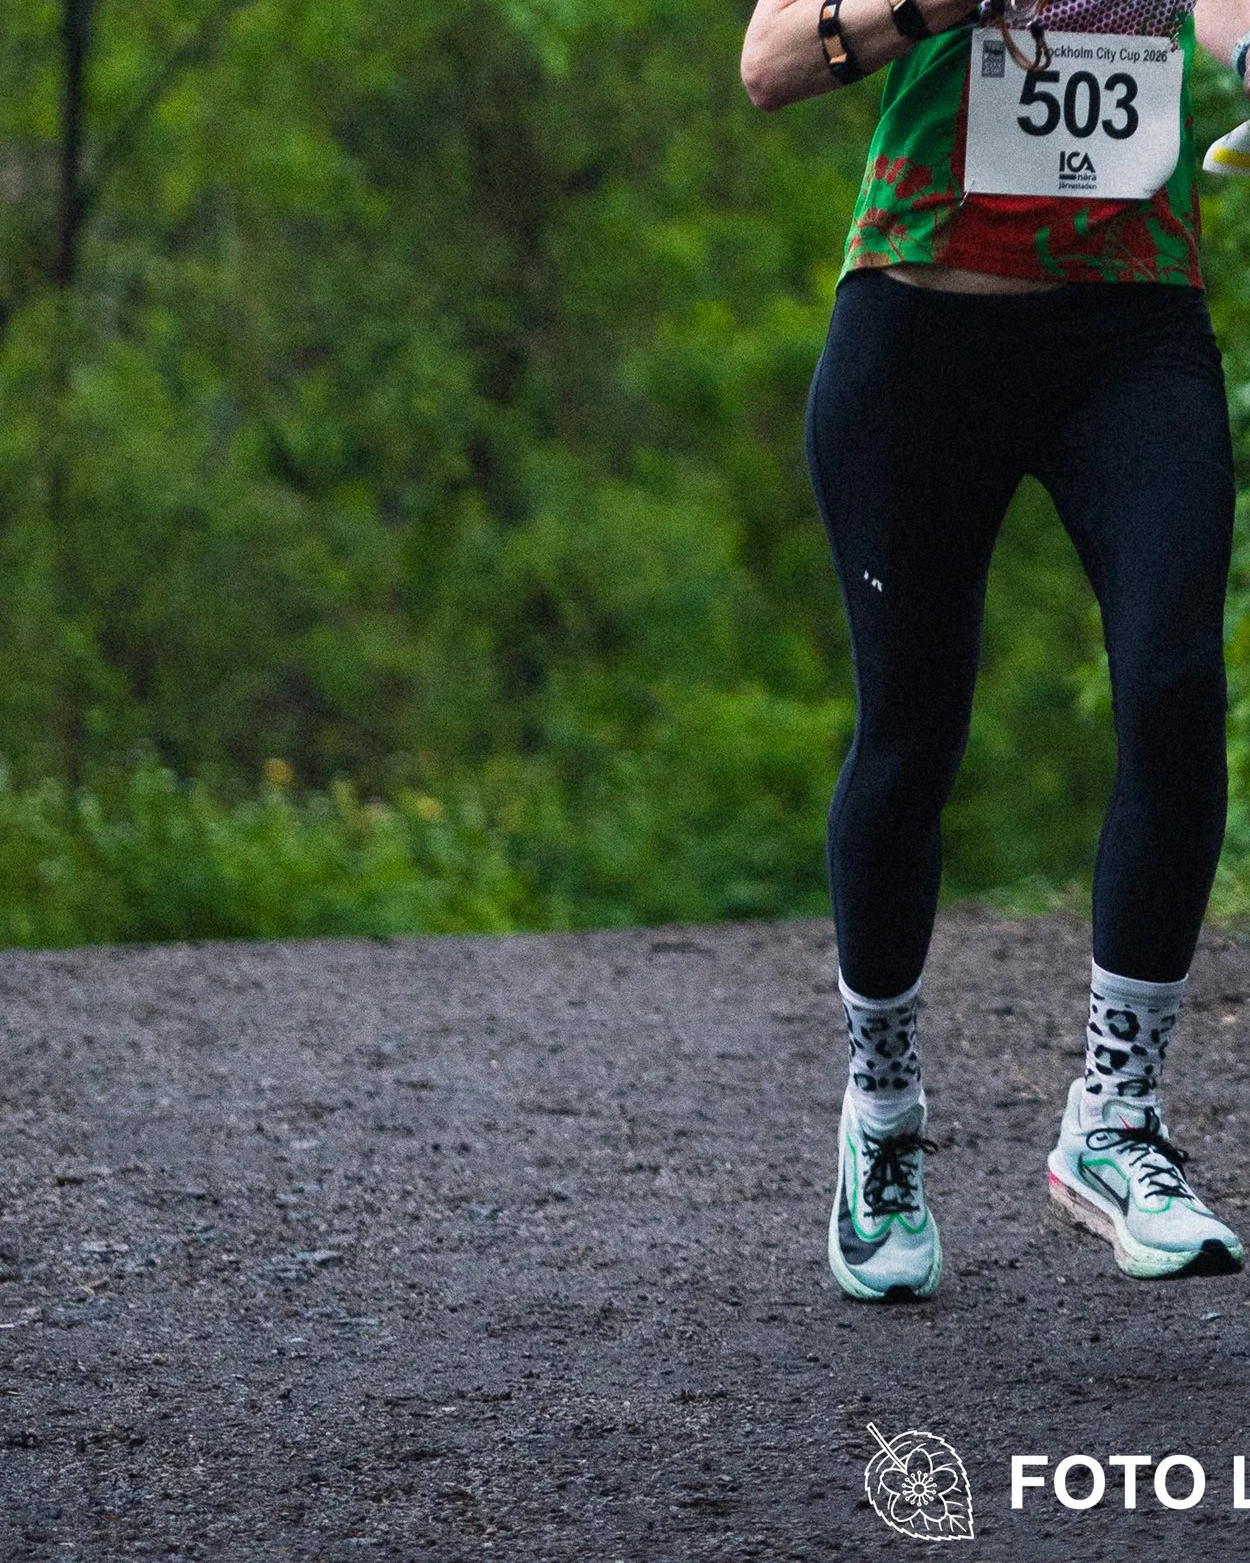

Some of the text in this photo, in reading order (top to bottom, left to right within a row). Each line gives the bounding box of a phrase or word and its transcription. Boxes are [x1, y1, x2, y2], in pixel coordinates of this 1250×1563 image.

[1044, 44, 1169, 64] ockholm City Cup 2026
[1016, 70, 1140, 140] 503
[1059, 150, 1096, 174] ICA
